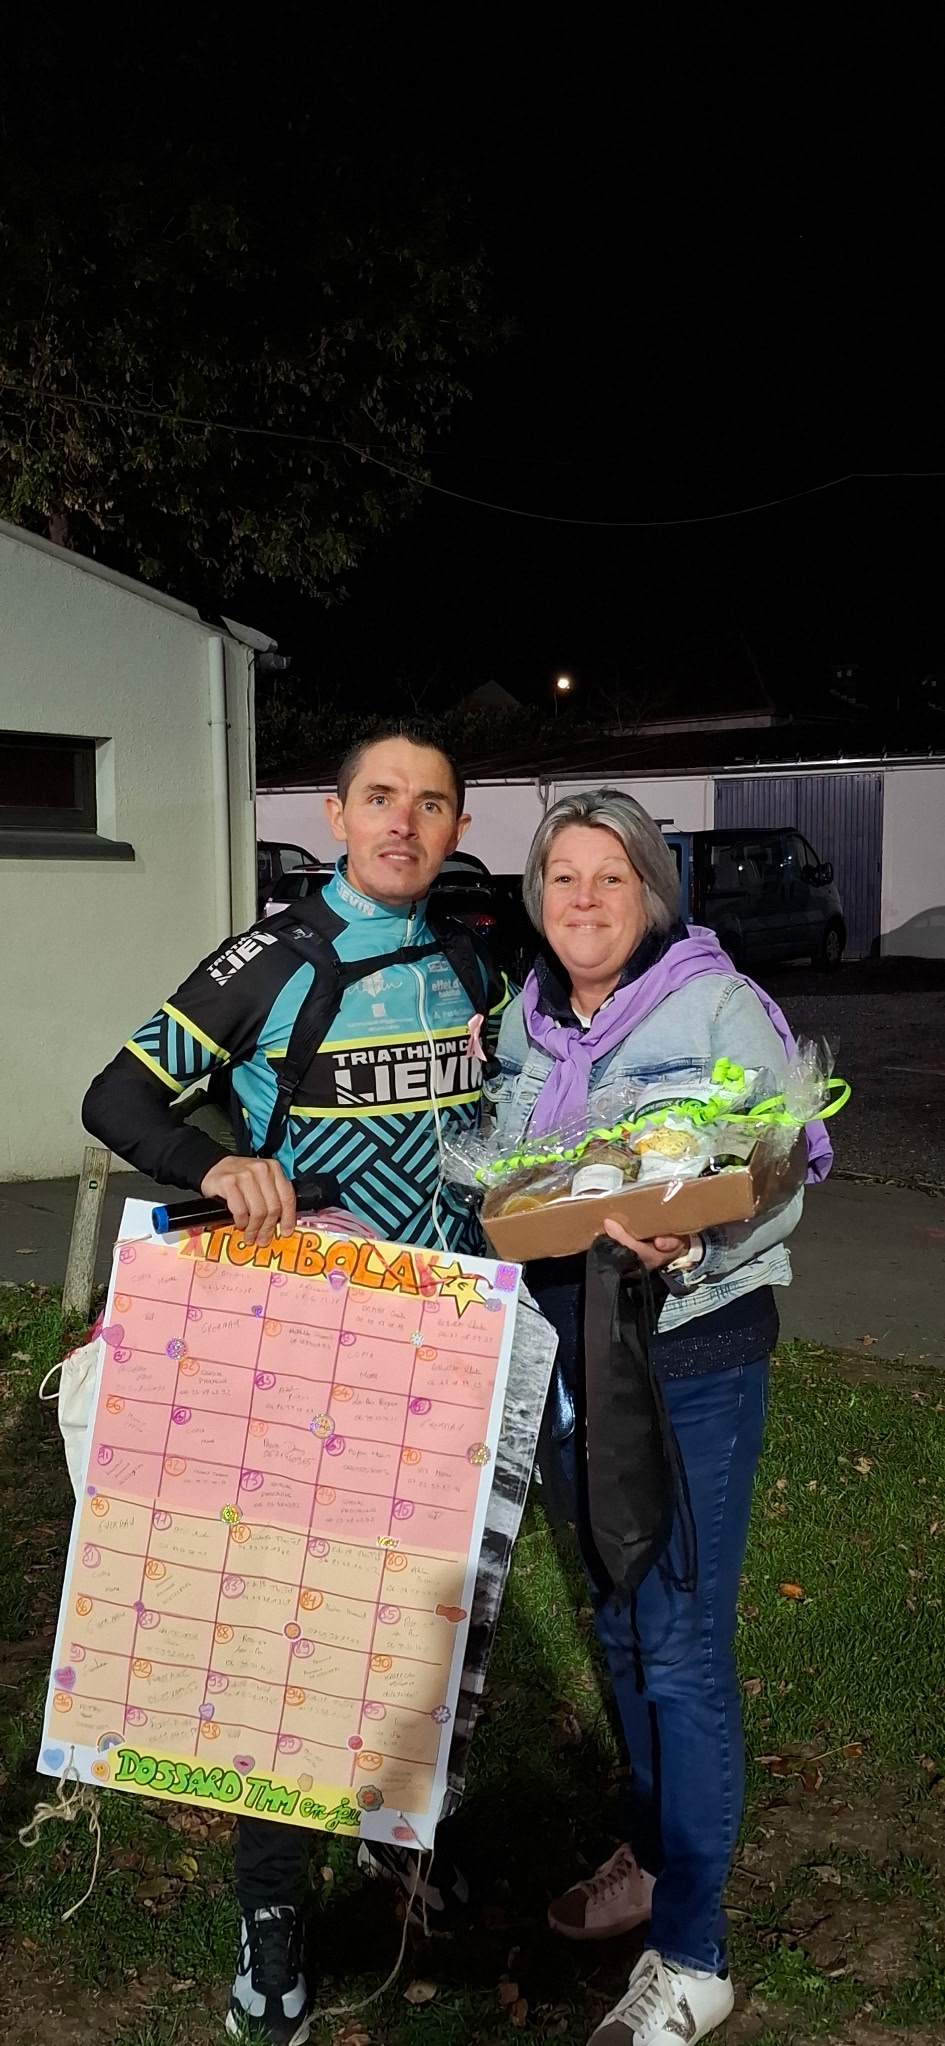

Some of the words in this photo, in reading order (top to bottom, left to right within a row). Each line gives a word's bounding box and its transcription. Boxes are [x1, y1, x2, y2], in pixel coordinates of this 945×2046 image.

[332, 1040, 457, 1067] TRIATHLON
[204, 1227, 419, 1295] TOMBOLA
[115, 1749, 243, 1803] DOSSARD
[244, 1777, 301, 1816] TMM
[300, 1797, 328, 1820] en
[325, 1797, 362, 1831] jeu
